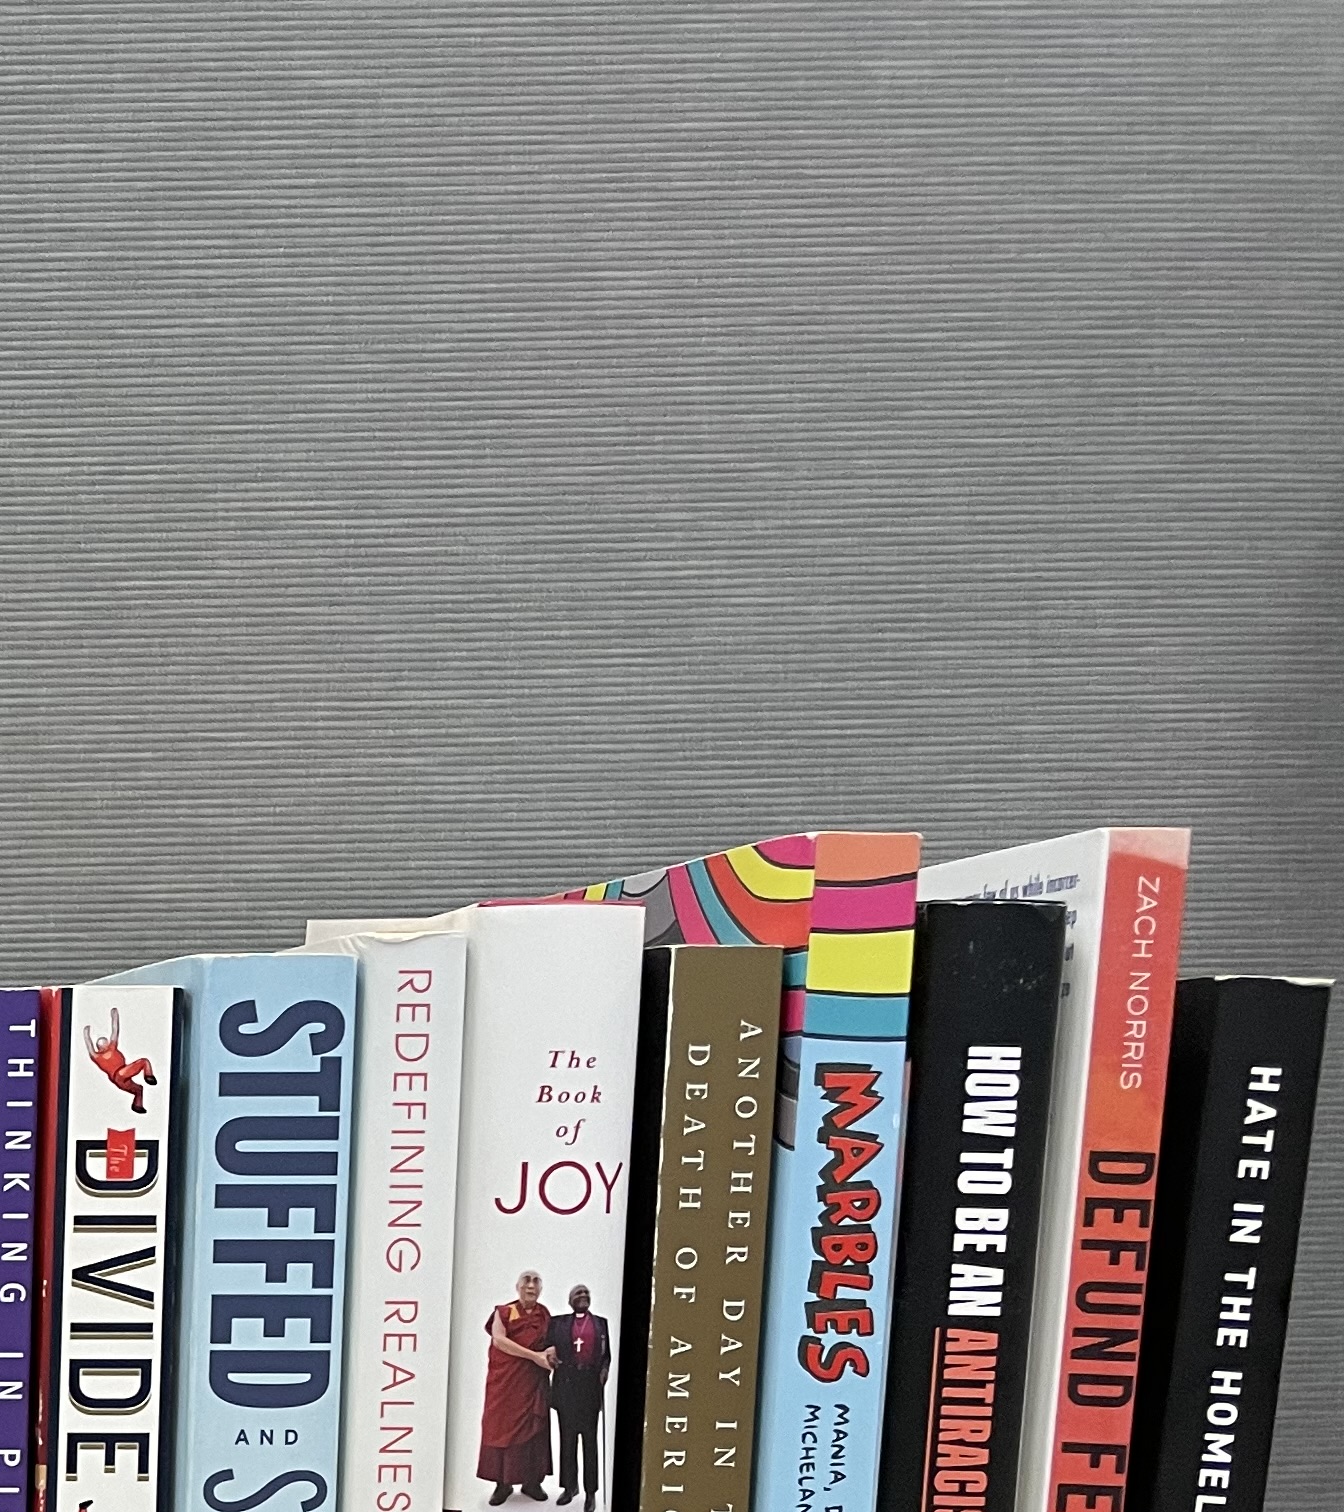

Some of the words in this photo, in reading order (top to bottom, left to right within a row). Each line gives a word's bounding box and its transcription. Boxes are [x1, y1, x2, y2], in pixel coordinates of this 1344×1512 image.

[548, 1050, 597, 1069] The
[961, 1045, 1022, 1137] HOW
[385, 969, 432, 1273] REDEFINING
[535, 1085, 602, 1104] Book
[1236, 1065, 1283, 1181] HATE
[0, 1019, 36, 1303] THINKING
[555, 1118, 586, 1146] of
[208, 999, 346, 1409] STUFFED
[494, 1161, 623, 1215] JOY
[957, 1149, 1013, 1195] TO
[798, 1063, 884, 1383] MARBLES
[953, 1208, 1009, 1253] BE
[1228, 1203, 1265, 1245] IN
[65, 1140, 160, 1482] DIVIDE
[947, 1263, 1004, 1317] AN
[1066, 1149, 1156, 1409] DEFUND
[1216, 1267, 1256, 1349] THE
[234, 1429, 299, 1445] AND
